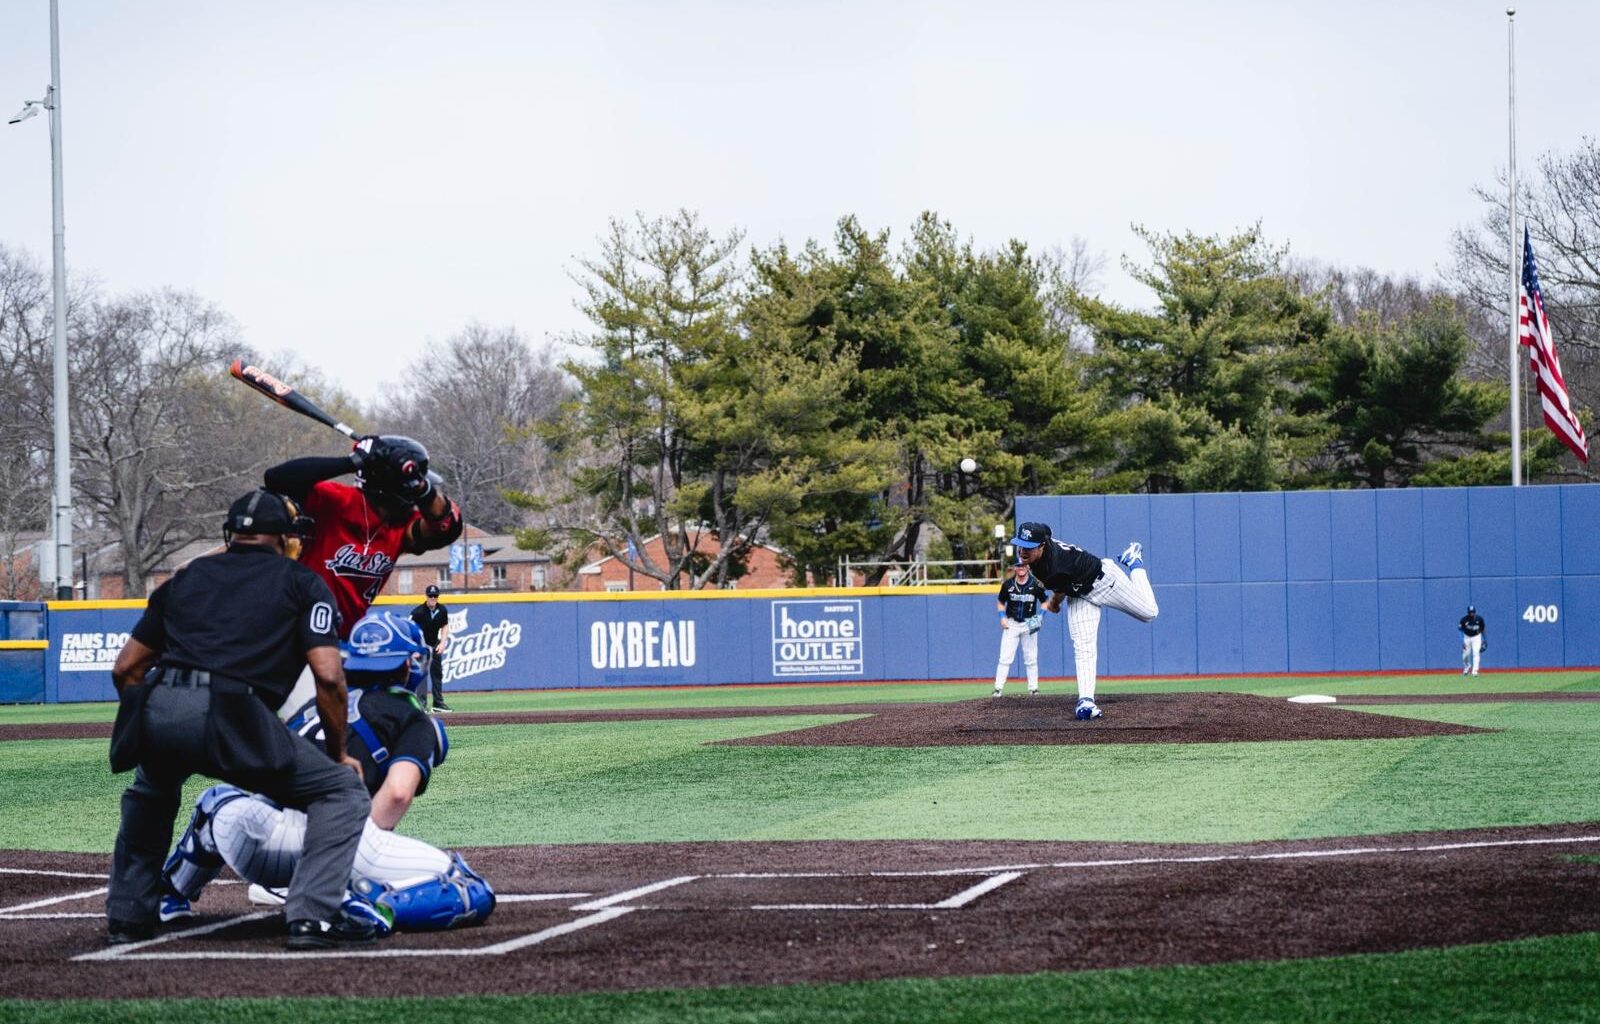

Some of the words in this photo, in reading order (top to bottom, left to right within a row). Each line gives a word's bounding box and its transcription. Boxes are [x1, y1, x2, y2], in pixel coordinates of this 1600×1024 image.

[325, 544, 369, 571] Jax
[781, 607, 854, 638] home
[1522, 604, 1558, 623] 400
[62, 633, 104, 650] FANS
[591, 620, 696, 669] OXBEAU
[781, 642, 854, 661] OUTLET
[60, 649, 96, 663] FANS
[442, 650, 506, 682] Farms
